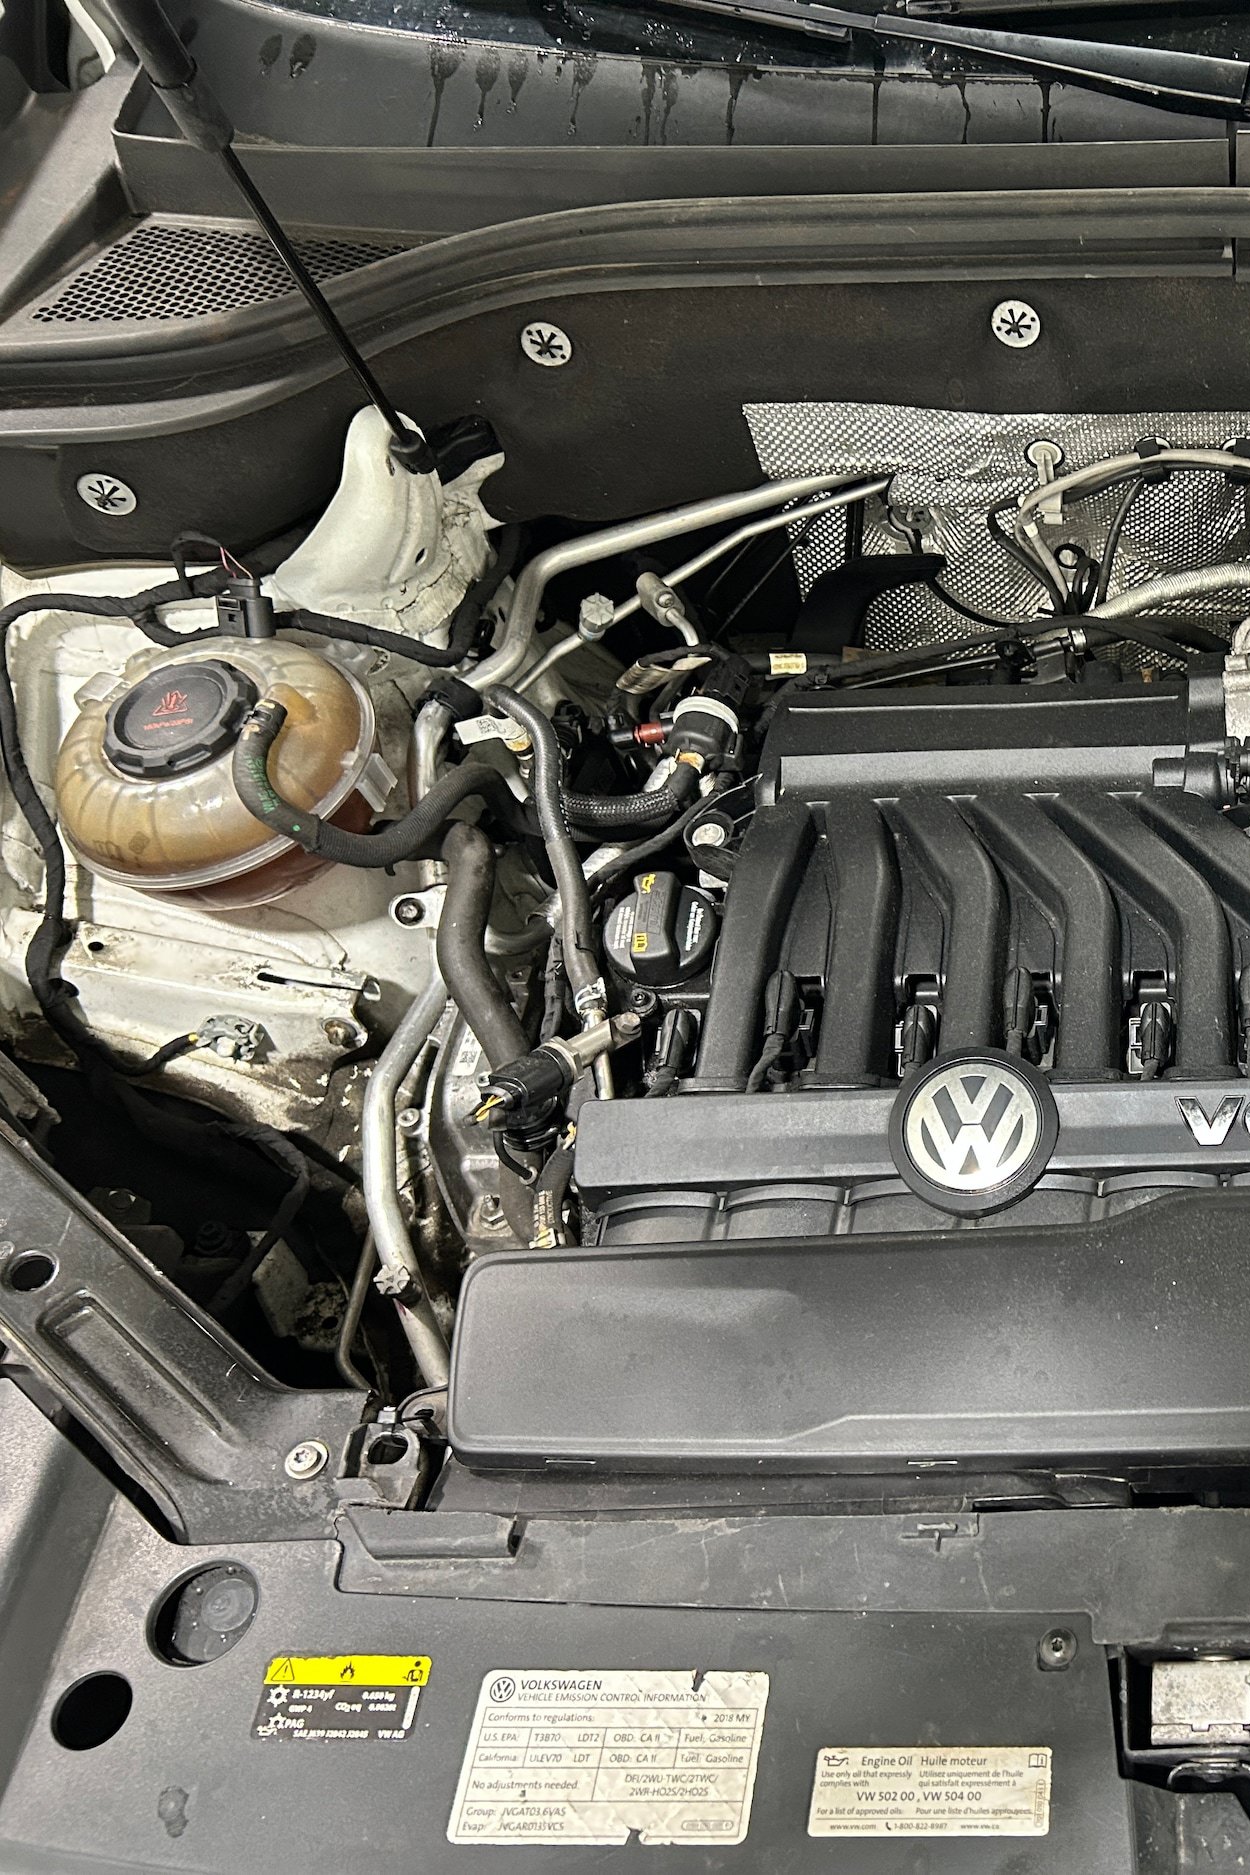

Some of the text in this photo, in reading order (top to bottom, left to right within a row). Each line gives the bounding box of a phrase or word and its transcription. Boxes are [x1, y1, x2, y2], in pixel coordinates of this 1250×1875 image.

[521, 1680, 602, 1691] VOLKSWAGEN
[292, 1689, 335, 1701] R-1234yf
[518, 1693, 707, 1702] VEHICLE EMISSION CONTROL INFORMATION
[488, 1713, 530, 1722] Conforms
[532, 1714, 541, 1722] to
[714, 1714, 733, 1722] 2018
[736, 1714, 751, 1722] MY
[284, 1719, 305, 1729] PAG
[377, 1730, 393, 1738] VW
[534, 1733, 561, 1742] T3B70
[577, 1733, 600, 1742] LDT2
[640, 1734, 653, 1742] CA
[709, 1734, 747, 1743] Gasoline
[529, 1753, 562, 1762] ULEV70
[574, 1754, 590, 1762] LDT
[636, 1754, 648, 1762] CA
[705, 1754, 743, 1763] Gasoline
[862, 1756, 987, 1769] Engine Oil Huile moteur
[836, 1771, 851, 1779] only
[880, 1771, 912, 1779] expressly
[947, 1771, 990, 1780] uniquement
[472, 1780, 485, 1789] No
[487, 1780, 542, 1791] adjustments
[919, 1780, 930, 1788] qui
[961, 1780, 1010, 1788] expressément
[857, 1792, 875, 1801] VW
[878, 1792, 898, 1801] 502
[900, 1792, 915, 1801] 00
[923, 1792, 942, 1801] VW
[945, 1792, 964, 1801] 504
[967, 1792, 982, 1801] 00
[466, 1807, 496, 1818] Group:
[846, 1807, 855, 1815] of
[856, 1808, 889, 1816] approved
[916, 1807, 932, 1815] Pour
[947, 1807, 962, 1815] liste
[462, 1822, 487, 1833] Evap:
